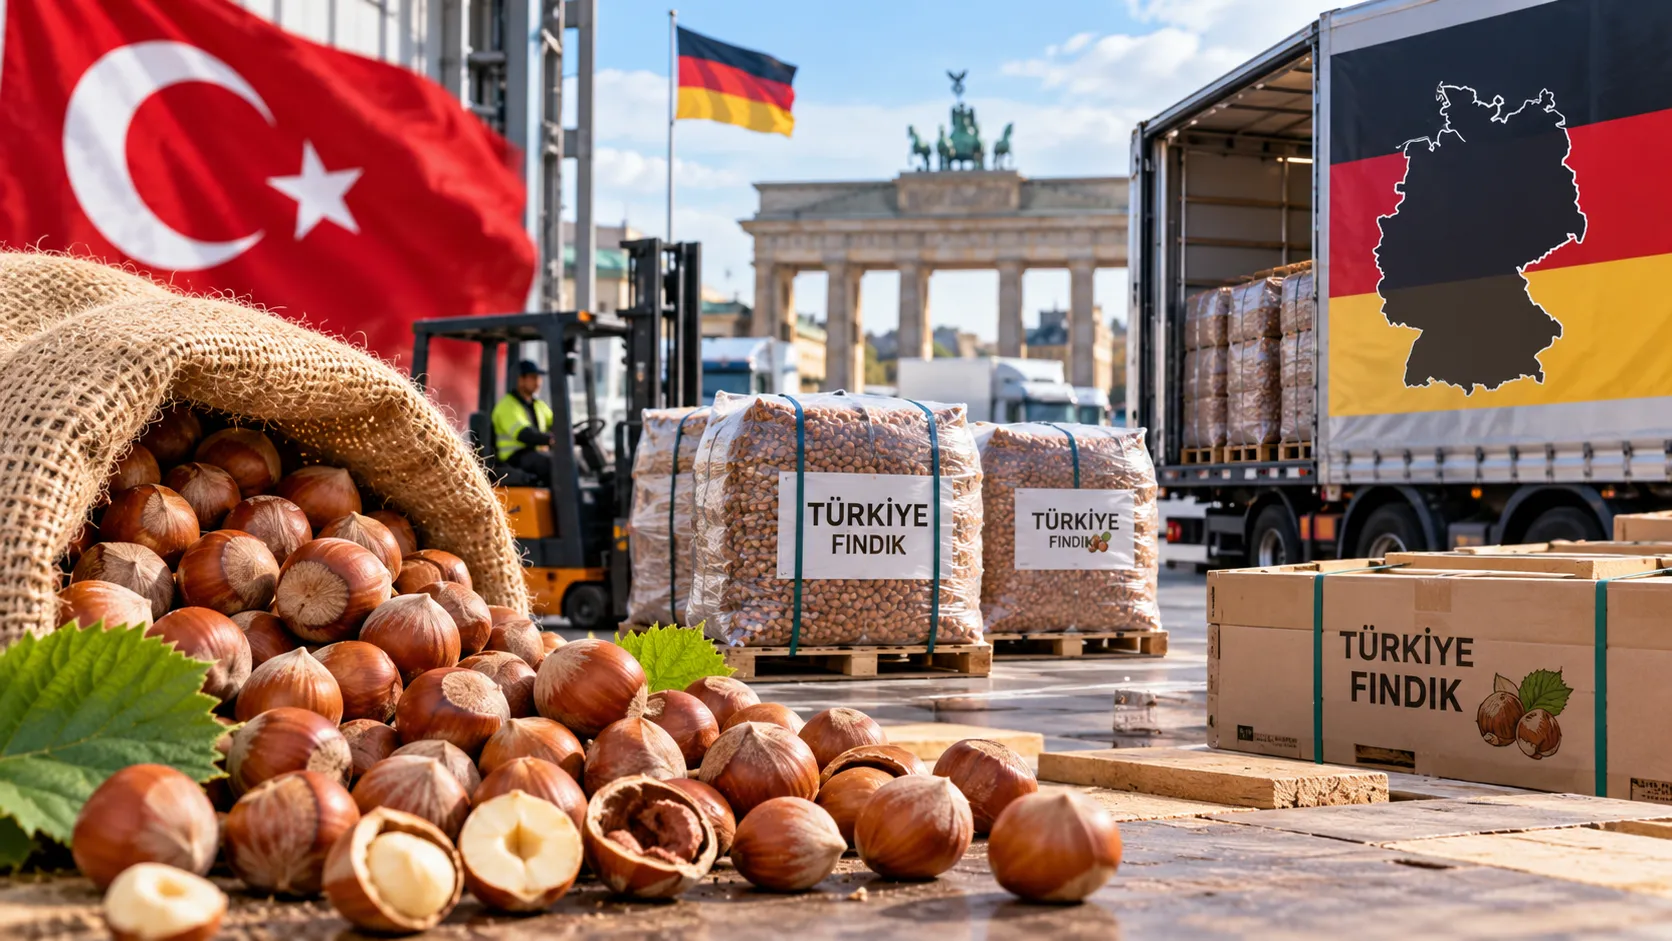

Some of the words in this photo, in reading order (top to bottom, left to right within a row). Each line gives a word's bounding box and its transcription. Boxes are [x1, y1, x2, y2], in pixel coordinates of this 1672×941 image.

[807, 496, 928, 527] TÜRKİYE
[1031, 507, 1120, 531] TÜRKİYE
[831, 533, 907, 556] FINDIK
[1339, 624, 1475, 668] TÜRKİYE
[1350, 670, 1464, 713] FINDIK
